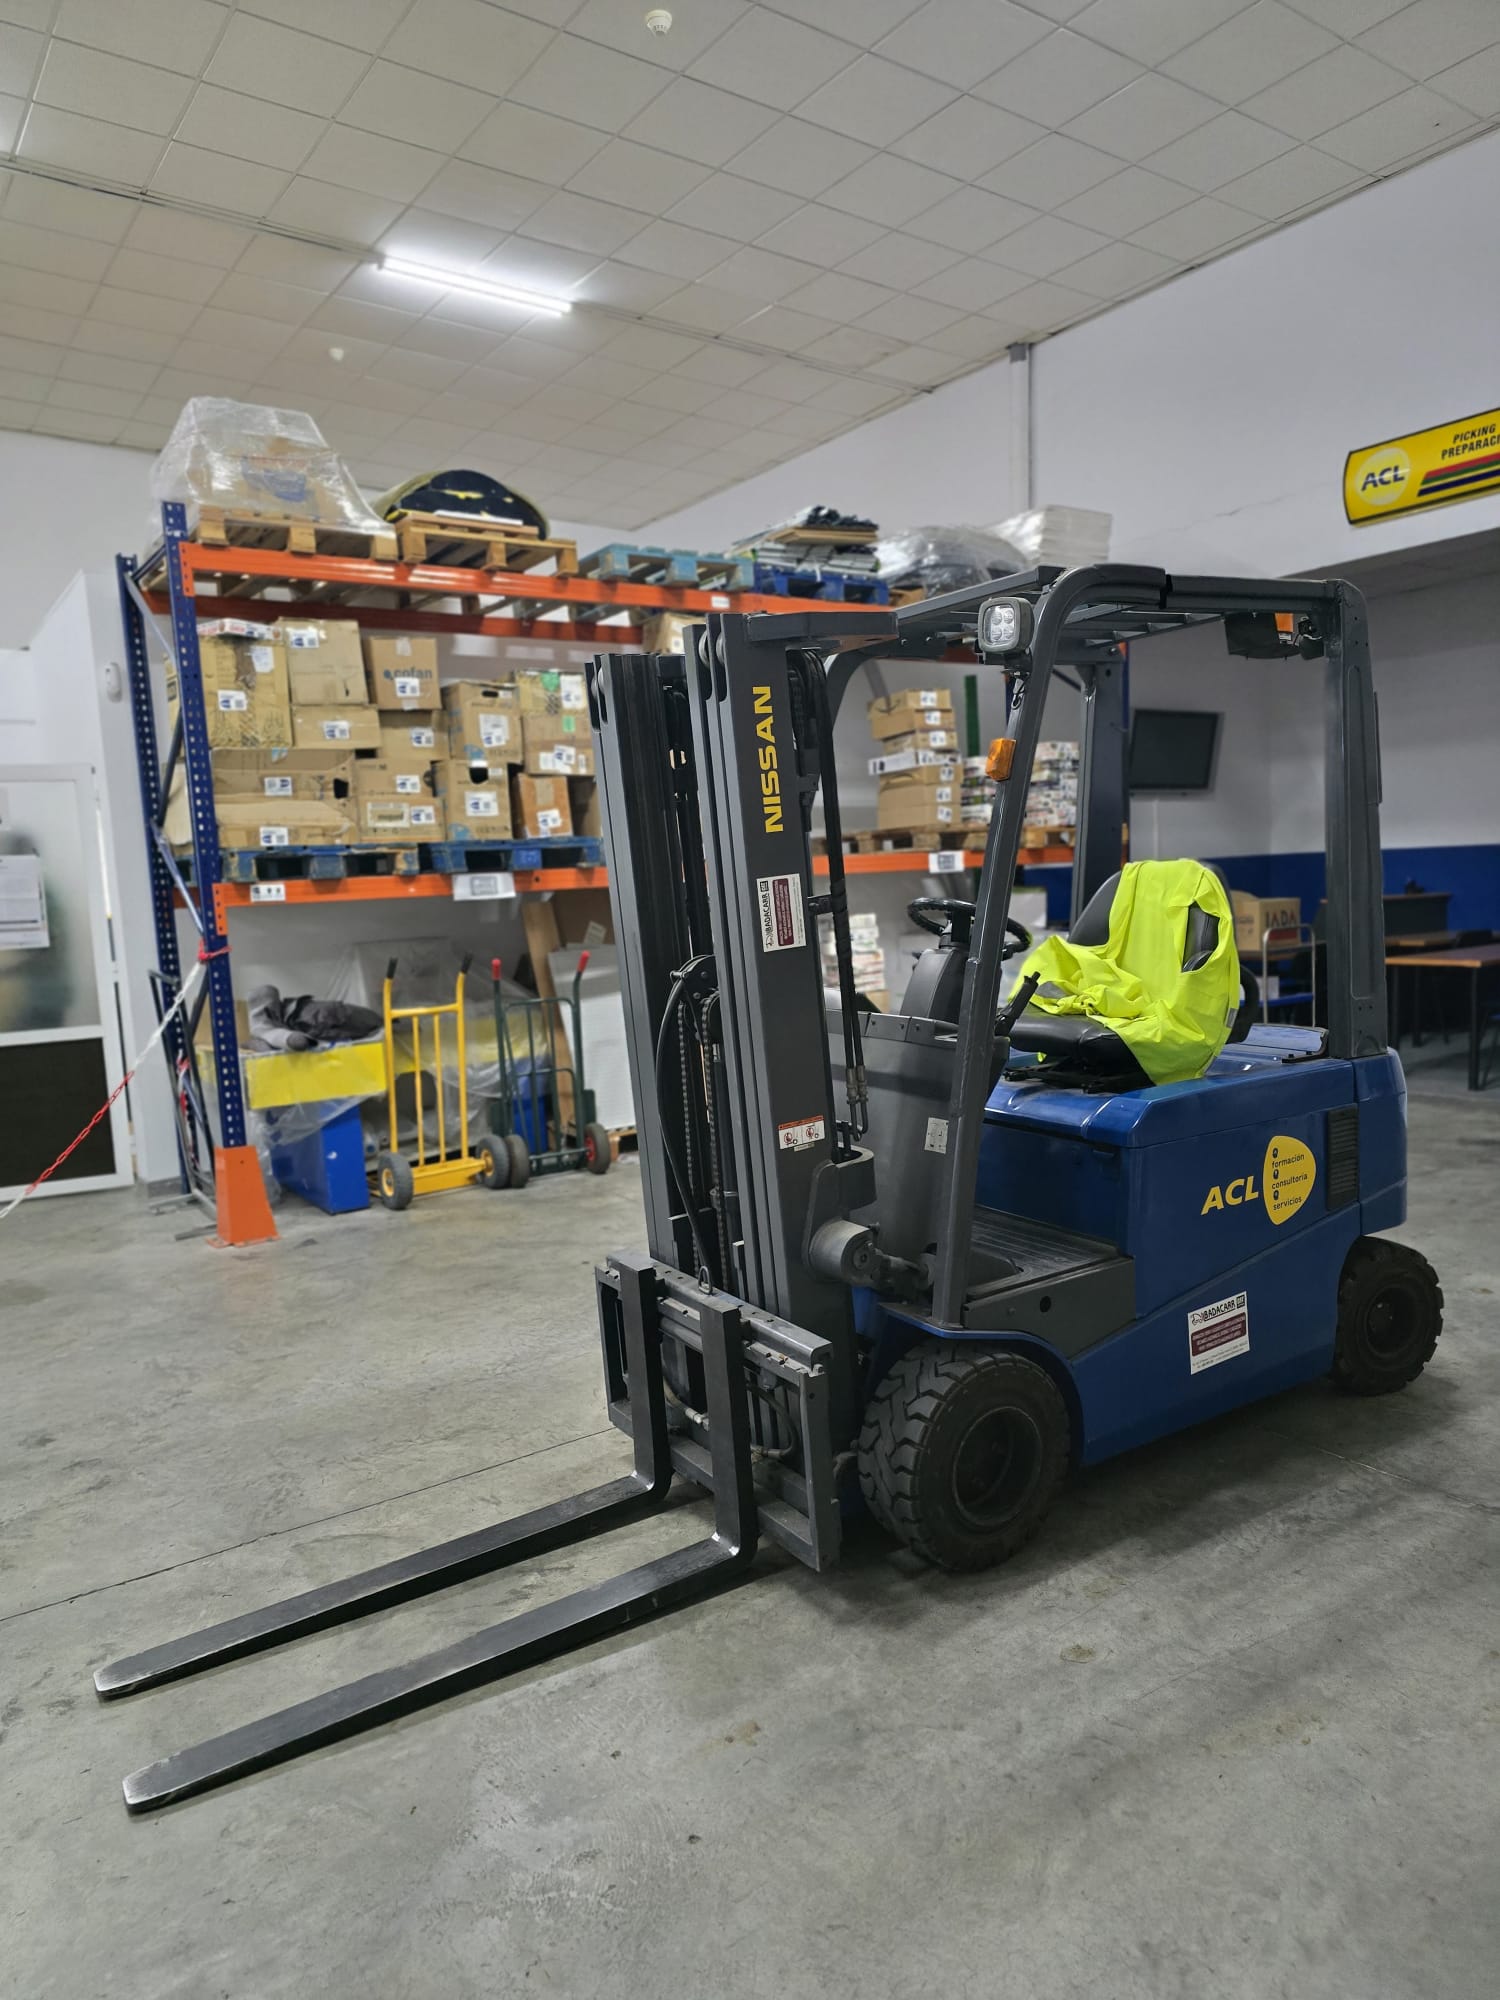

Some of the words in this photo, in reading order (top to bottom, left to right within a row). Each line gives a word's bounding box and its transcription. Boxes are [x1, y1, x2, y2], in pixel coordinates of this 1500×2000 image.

[1453, 424, 1496, 444] PICKING
[1361, 465, 1405, 491] ACL
[752, 686, 784, 833] NISSAN
[1201, 1176, 1259, 1216] ACL
[1273, 1197, 1302, 1211] servicios
[1204, 1300, 1236, 1319] BADACARR
